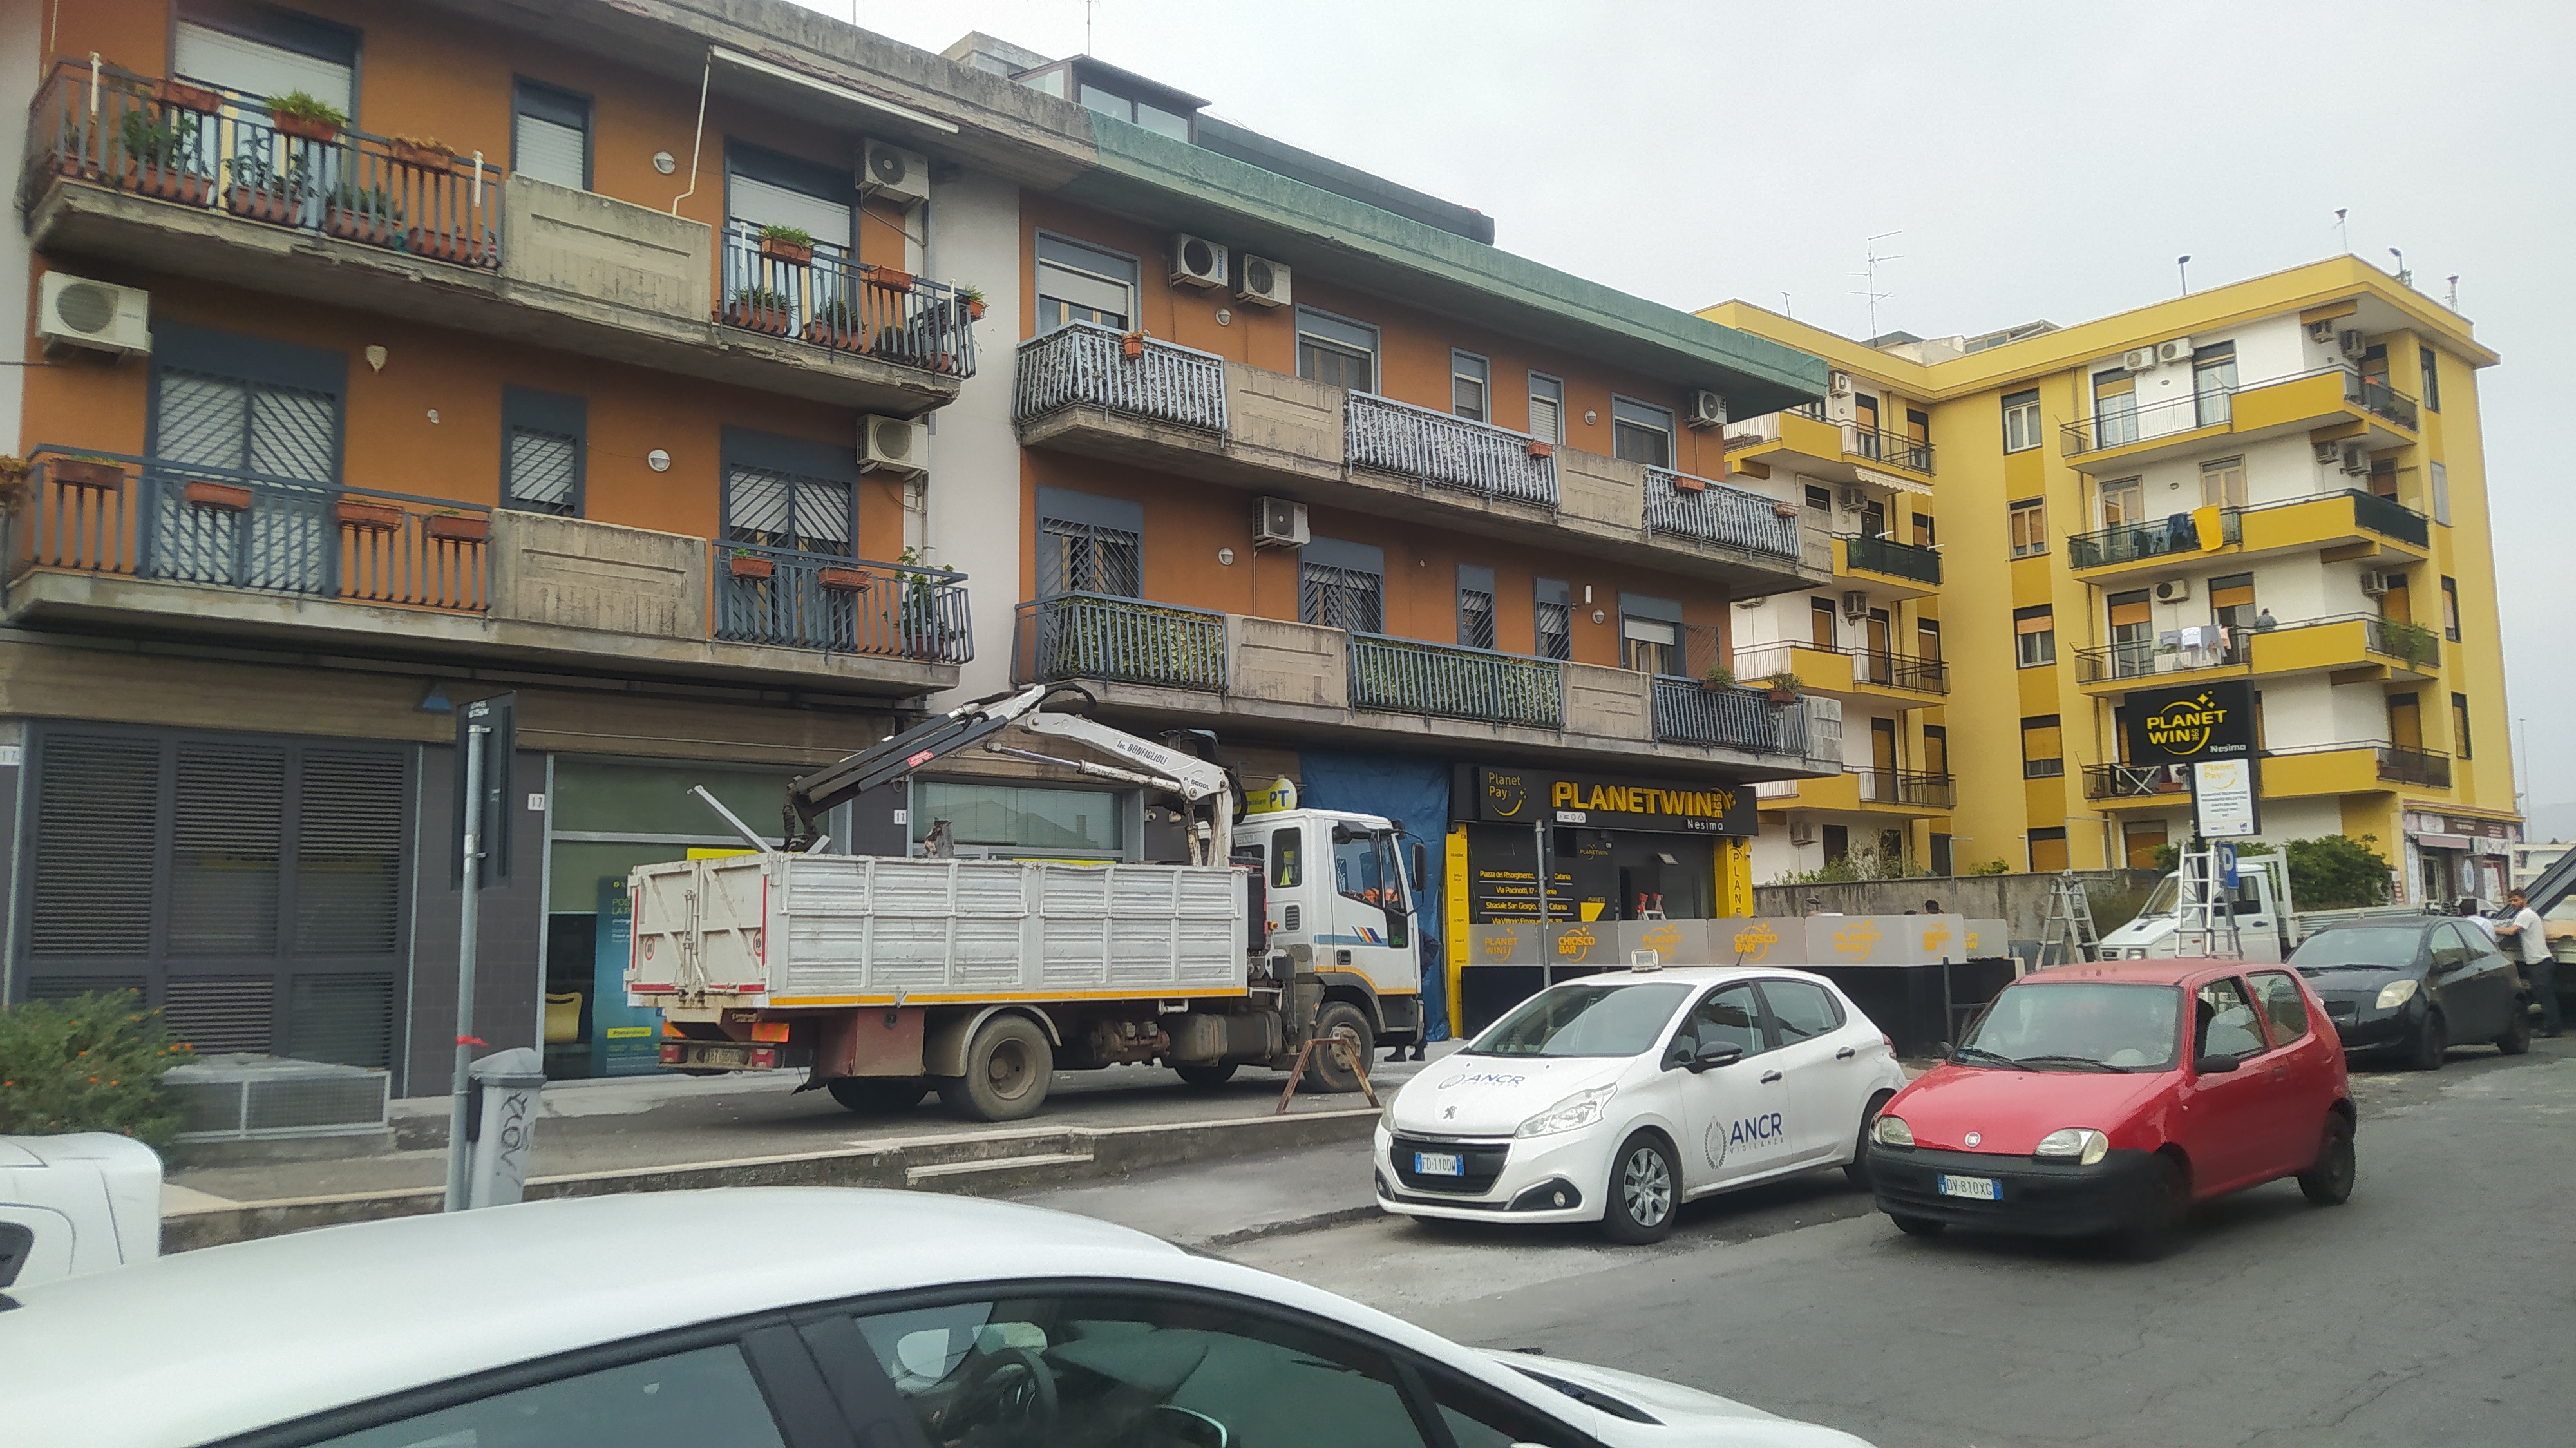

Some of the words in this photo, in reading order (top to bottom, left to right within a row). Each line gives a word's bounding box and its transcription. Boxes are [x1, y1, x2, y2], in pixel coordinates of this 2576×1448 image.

[2146, 710, 2227, 730] PLANET
[2148, 729, 2190, 745] WIN
[1126, 743, 1168, 765] BONFIGLIOLI
[2209, 743, 2247, 754] Nesima
[1488, 772, 1522, 786] Planet
[1269, 790, 1289, 808] PT
[1488, 785, 1508, 801] Pay
[1551, 781, 1712, 817] PLANETWIN
[532, 796, 543, 808] 17
[1711, 793, 1723, 819] 365
[1687, 819, 1724, 831] Nesima
[1479, 870, 1495, 878] Piazza
[1549, 902, 1568, 911] Catania
[1558, 937, 1595, 946] CHIOSCO
[1734, 934, 1777, 944] CHIOSCO
[1558, 945, 1577, 954] BAR
[1735, 944, 1756, 953] BAR
[1464, 1074, 1526, 1085] ANCR
[1730, 1112, 1783, 1147] ANCR
[1730, 1137, 1785, 1154] VIGILANZA
